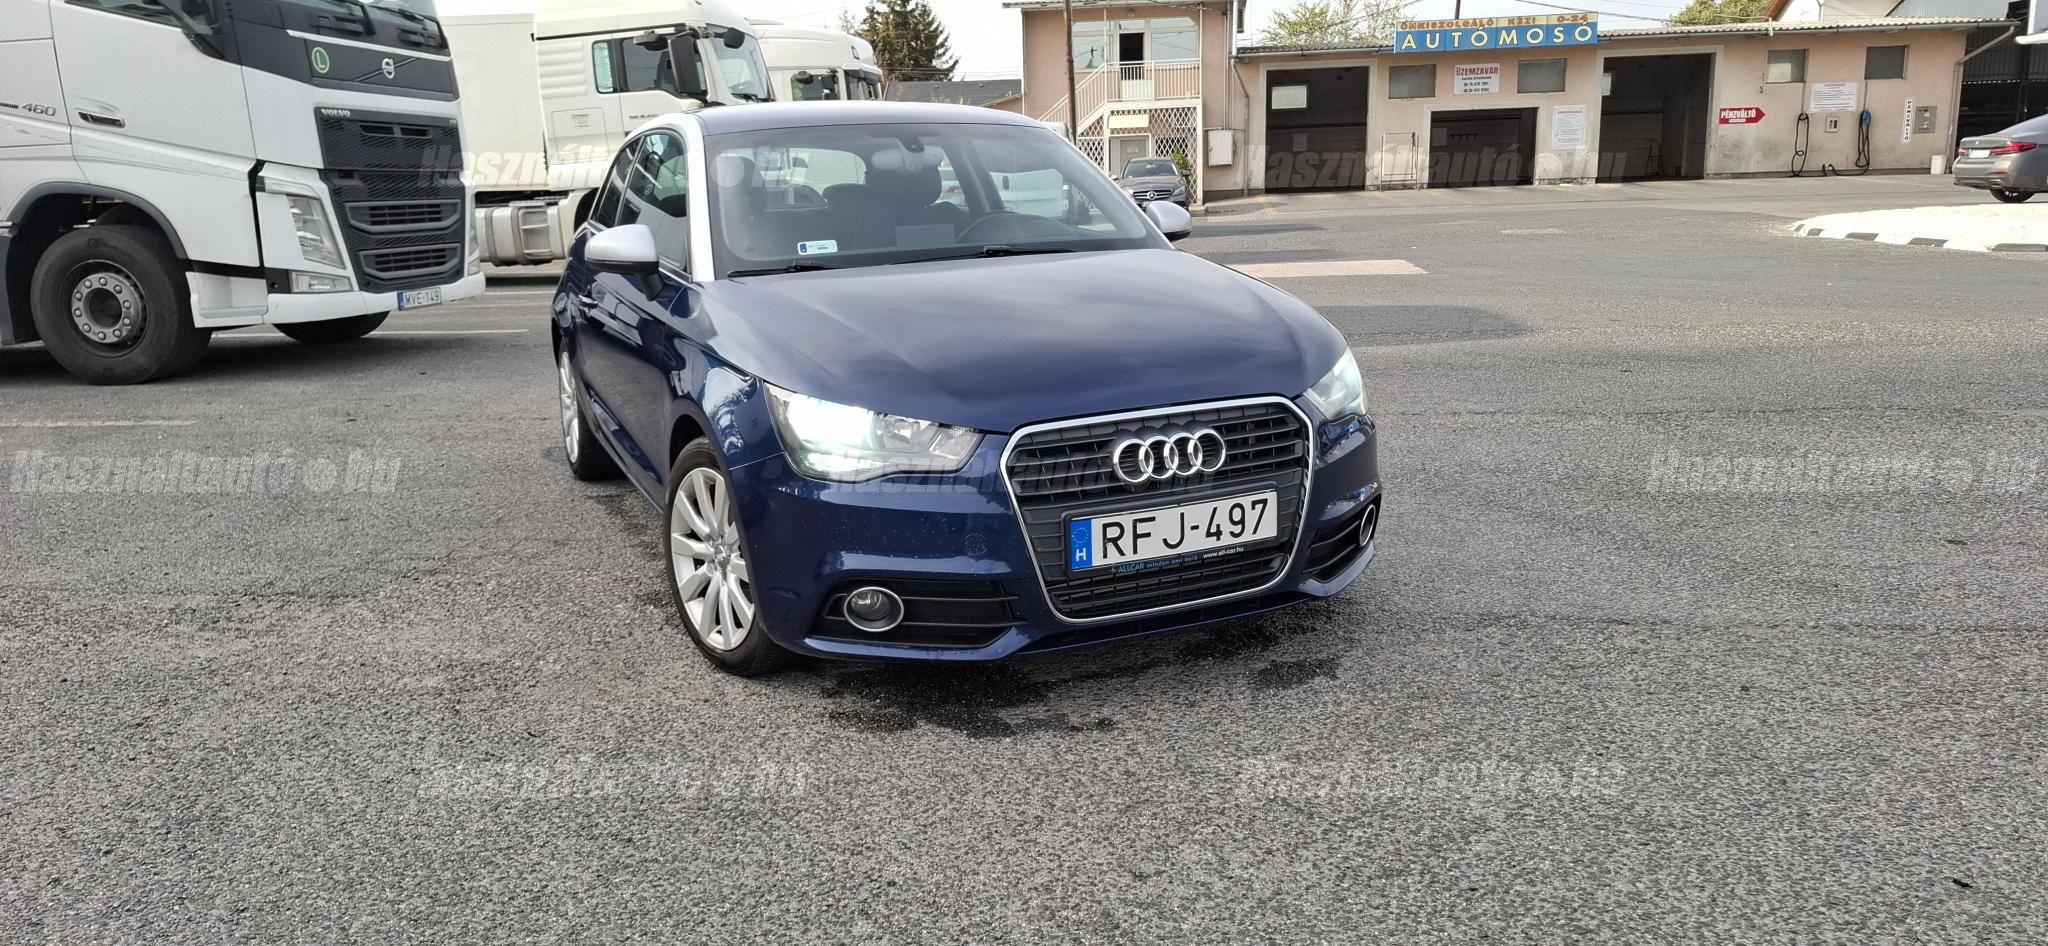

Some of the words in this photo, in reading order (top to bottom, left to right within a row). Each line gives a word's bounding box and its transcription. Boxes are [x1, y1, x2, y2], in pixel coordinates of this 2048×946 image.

[1508, 16, 1536, 26] KÉZI
[317, 54, 326, 69] L
[1456, 66, 1499, 76] ÜZEMZAVAR
[22, 103, 56, 116] 460
[320, 108, 350, 118] VOLVO
[405, 290, 440, 305] MVE-149
[1102, 498, 1269, 560] RFJ-497
[1075, 548, 1087, 562] H
[1118, 562, 1145, 573] ALLCAR
